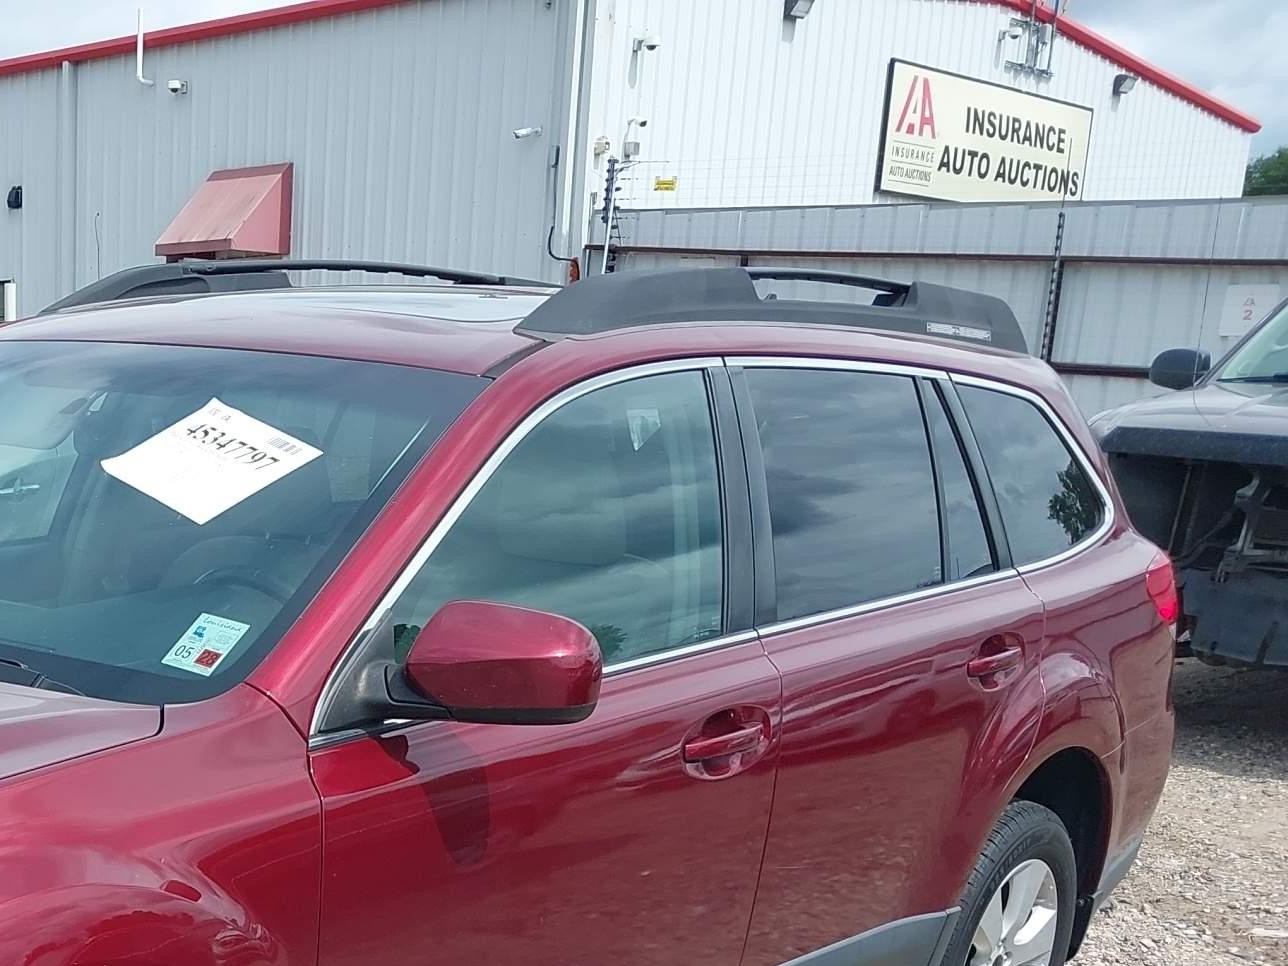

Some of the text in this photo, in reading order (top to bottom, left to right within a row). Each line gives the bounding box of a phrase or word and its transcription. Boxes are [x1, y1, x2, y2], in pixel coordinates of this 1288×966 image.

[964, 106, 1066, 154] INSURANCE
[891, 145, 935, 163] INSURANCE
[888, 165, 933, 182] AUTO AUCTIONS
[937, 145, 1080, 197] AUTO AUCTIONS
[1242, 309, 1253, 321] 2
[187, 423, 281, 470] 45347797
[174, 644, 195, 659] 05
[198, 650, 218, 665] 28
